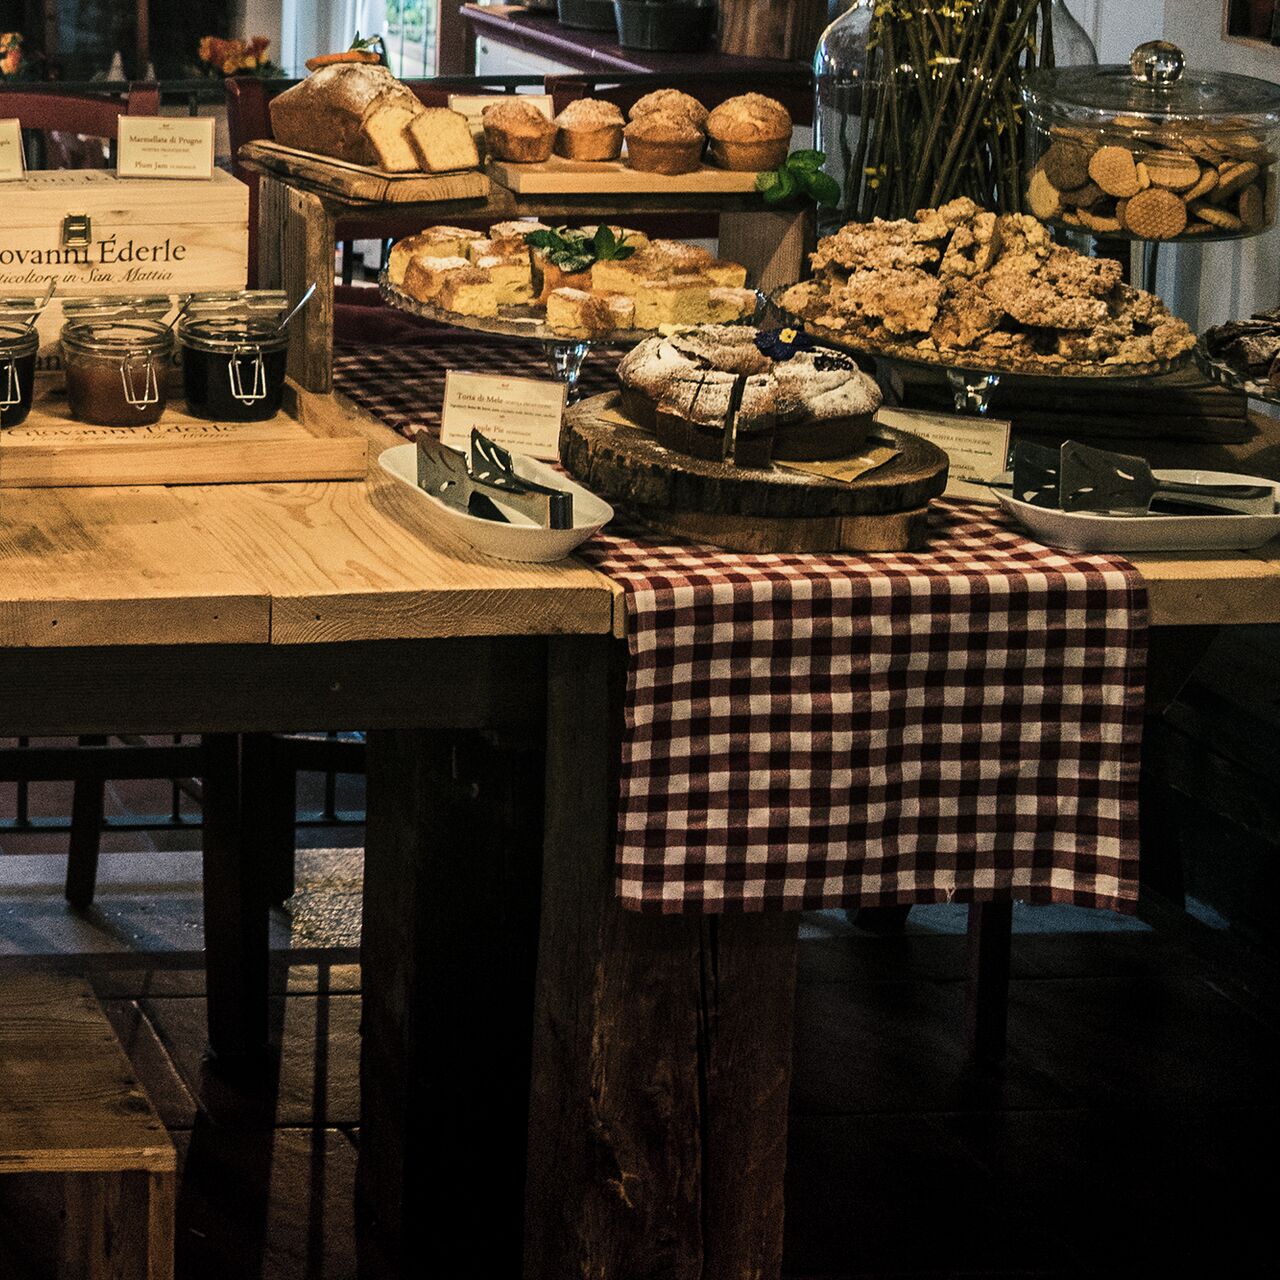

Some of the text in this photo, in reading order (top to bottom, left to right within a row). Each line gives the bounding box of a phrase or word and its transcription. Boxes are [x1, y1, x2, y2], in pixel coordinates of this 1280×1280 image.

[129, 135, 168, 144] Marmellata
[96, 234, 187, 264] Éderle
[62, 272, 79, 283] in
[80, 268, 112, 284] San
[118, 268, 174, 283] Mattia
